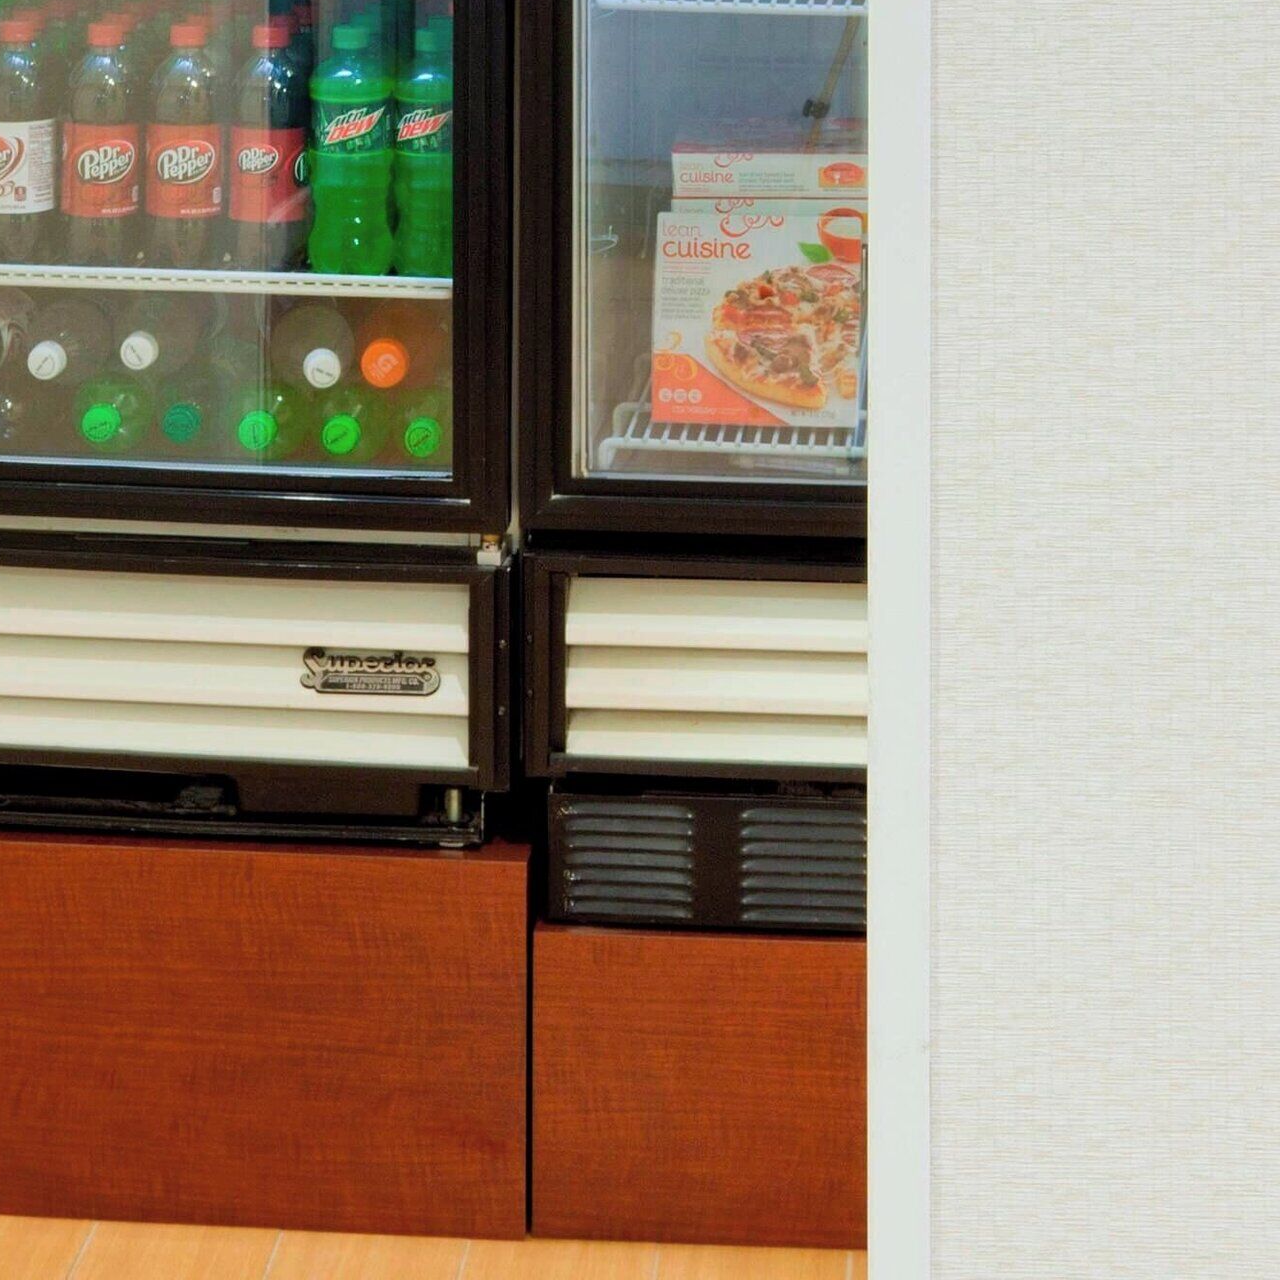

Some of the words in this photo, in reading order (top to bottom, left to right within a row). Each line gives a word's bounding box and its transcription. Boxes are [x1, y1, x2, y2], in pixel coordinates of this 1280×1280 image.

[98, 145, 122, 163] Dr
[177, 145, 201, 163] Dr
[239, 149, 276, 171] Pepper
[250, 147, 266, 159] Dr
[81, 149, 133, 180] Pepper
[160, 149, 213, 180] Pepper
[680, 169, 734, 184] cuisine
[663, 219, 703, 237] lean
[663, 238, 752, 259] cuisine
[301, 646, 437, 680] Superior
